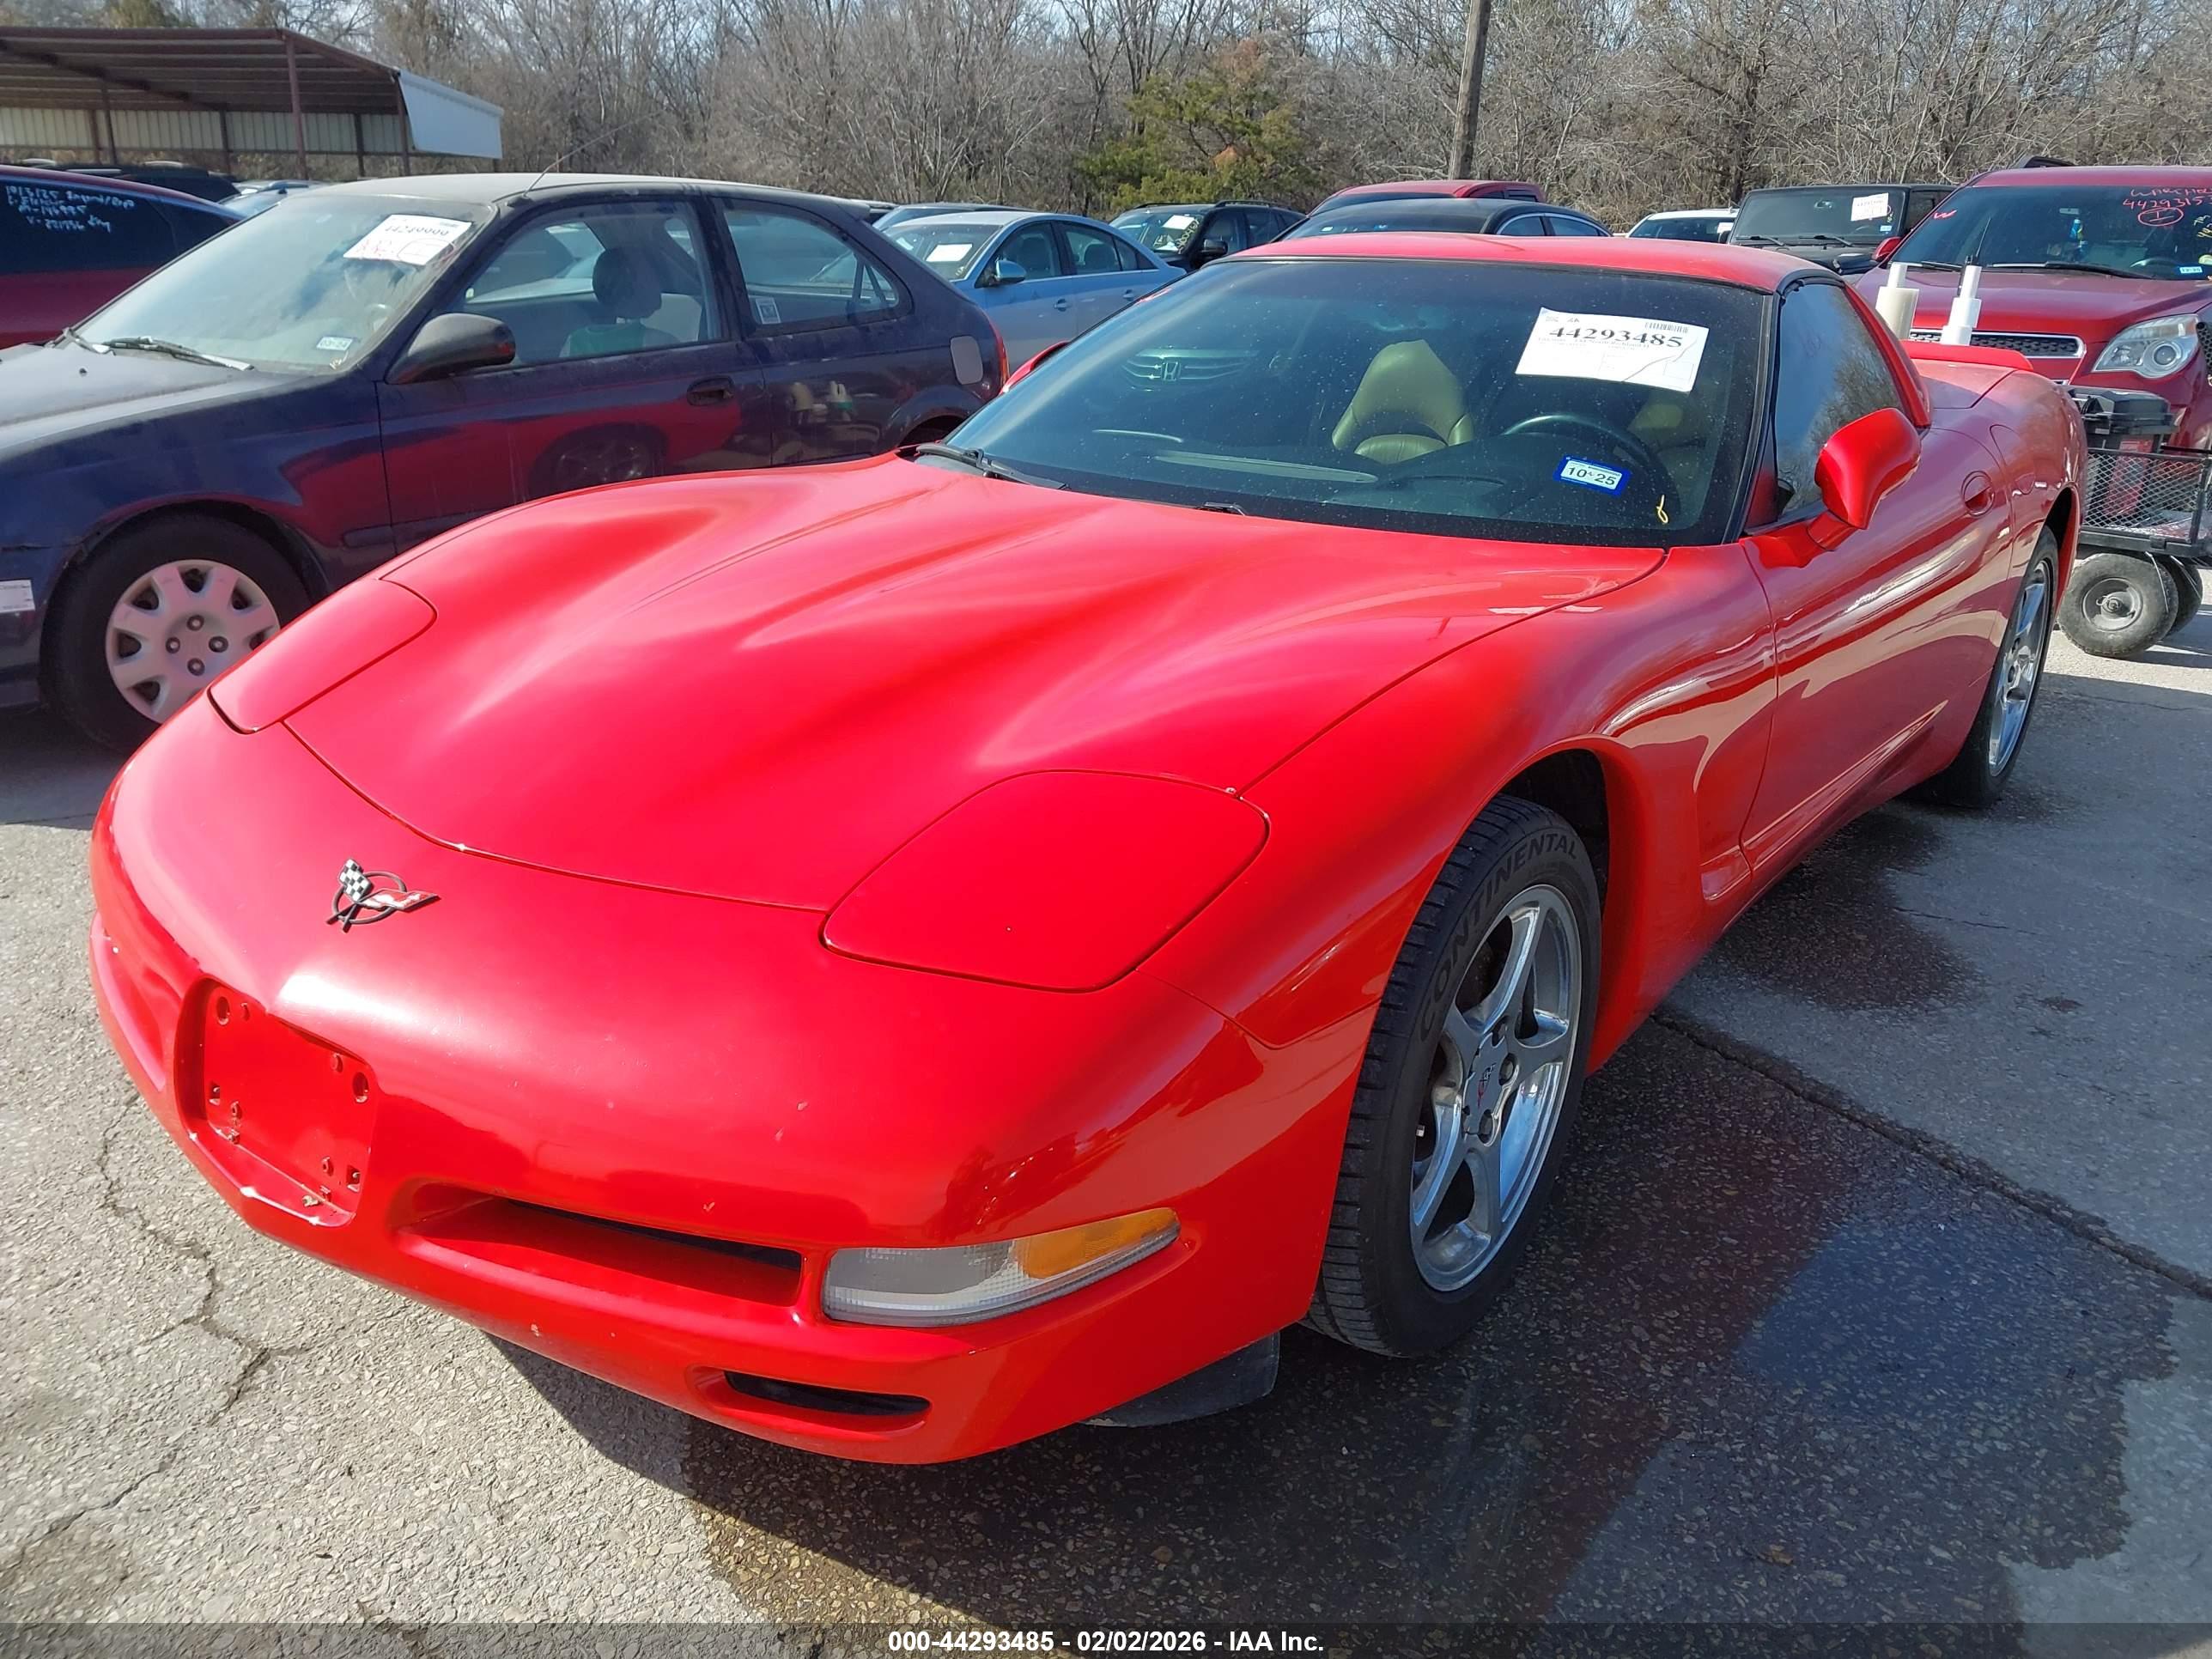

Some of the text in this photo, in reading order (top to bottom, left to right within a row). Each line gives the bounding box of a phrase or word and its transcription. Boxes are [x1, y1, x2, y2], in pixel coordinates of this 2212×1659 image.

[1549, 327, 1683, 348] 44293485
[1568, 467, 1617, 486] 10 25
[1420, 833, 1577, 1041] CONTINENTAL
